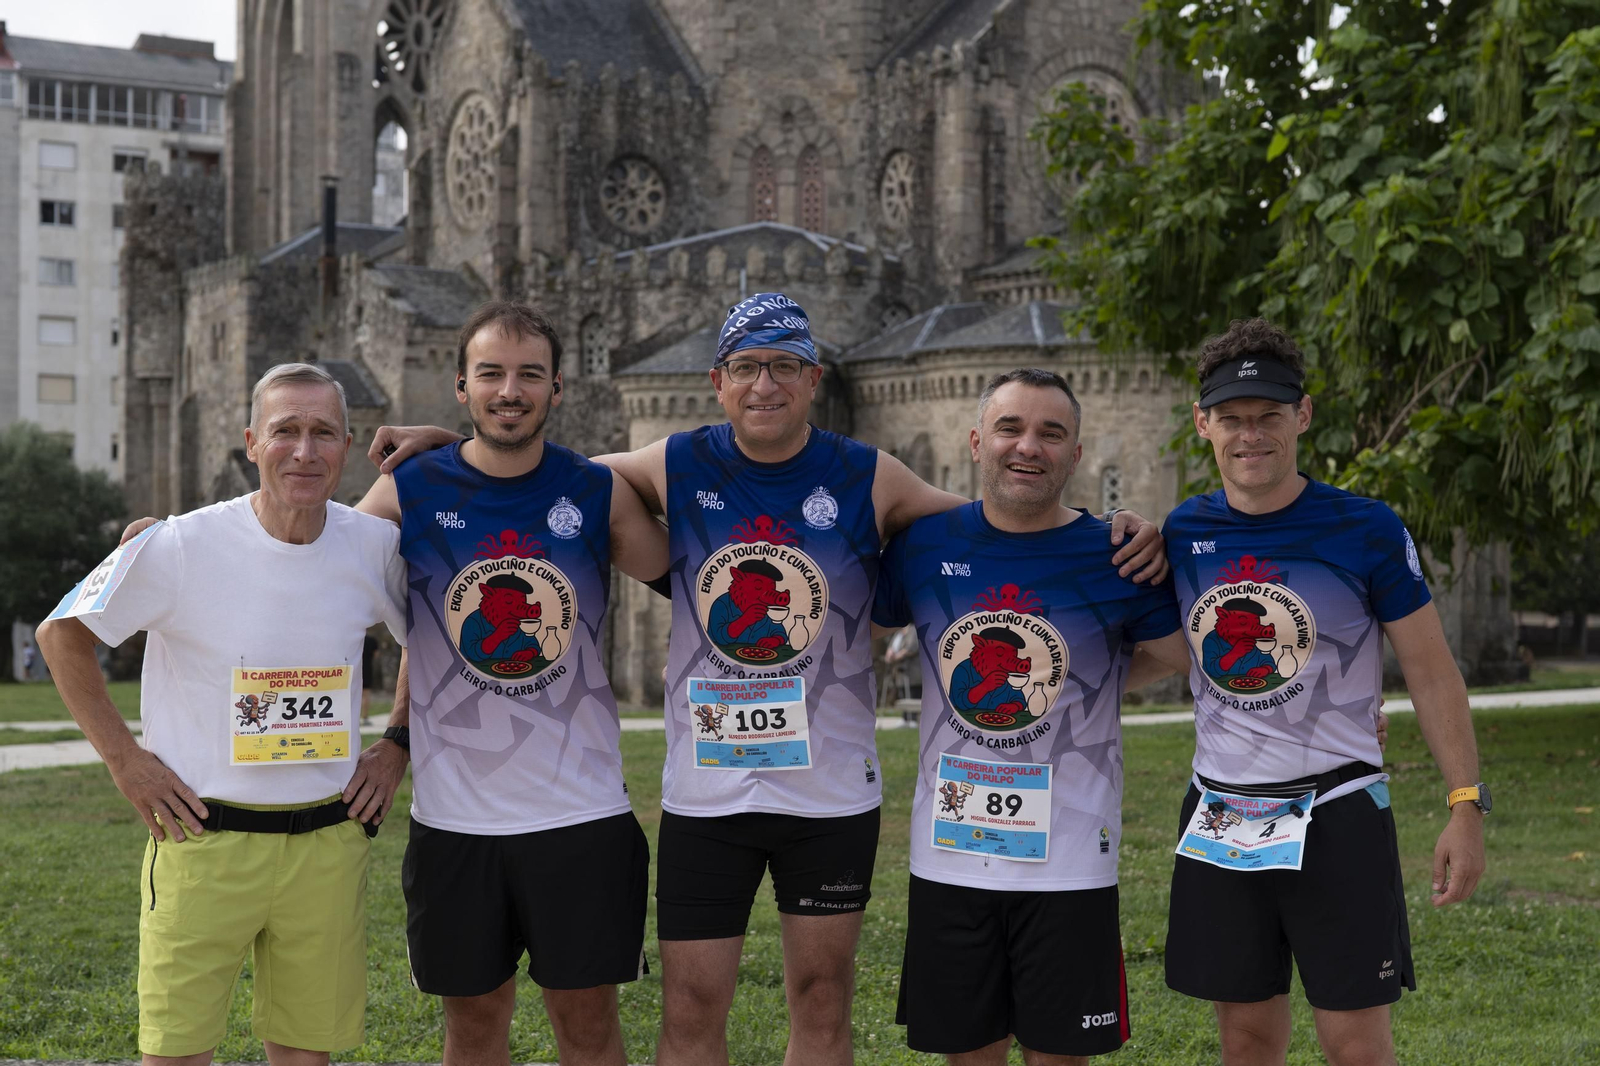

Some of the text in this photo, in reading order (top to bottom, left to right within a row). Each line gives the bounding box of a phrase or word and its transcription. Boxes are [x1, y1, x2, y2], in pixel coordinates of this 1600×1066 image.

[1238, 369, 1257, 378] ipso
[696, 490, 718, 500] RUN
[436, 512, 458, 520] RUN
[701, 544, 822, 620] EKIPO DO TOUCIÑO E CUNCA DE VIÑO
[450, 558, 572, 630] EKIPO DO TOUCIÑO E CUNCA DE VIÑO
[1191, 583, 1310, 650] EKIPO DO TOUCIÑO E CUNCA DE VIÑO
[942, 612, 1062, 688] EKIPO DO TOUCIÑO E CUNCA DE VIÑO
[250, 670, 298, 680] CARREIRA
[301, 669, 343, 678] POPULAR
[706, 650, 731, 674] LEIRO
[738, 671, 745, 679] O
[286, 679, 318, 688] PULPO
[459, 664, 567, 697] LEIRO O CARBALLIÑO
[705, 683, 747, 692] CARREIRA
[749, 680, 795, 691] POPULAR
[736, 691, 767, 700] PULPO
[1206, 682, 1304, 712] LEIRO O CARBALLIÑO
[282, 696, 334, 720] 342
[735, 708, 787, 732] 103
[947, 714, 1051, 749] LEIRO O CARBALLIÑO
[953, 760, 994, 774] CARREIRA
[997, 765, 1042, 776] POPULAR
[967, 772, 1014, 784] DO PULPO
[986, 793, 1023, 817] 89
[1259, 822, 1276, 838] 4
[1379, 969, 1395, 980] ipso
